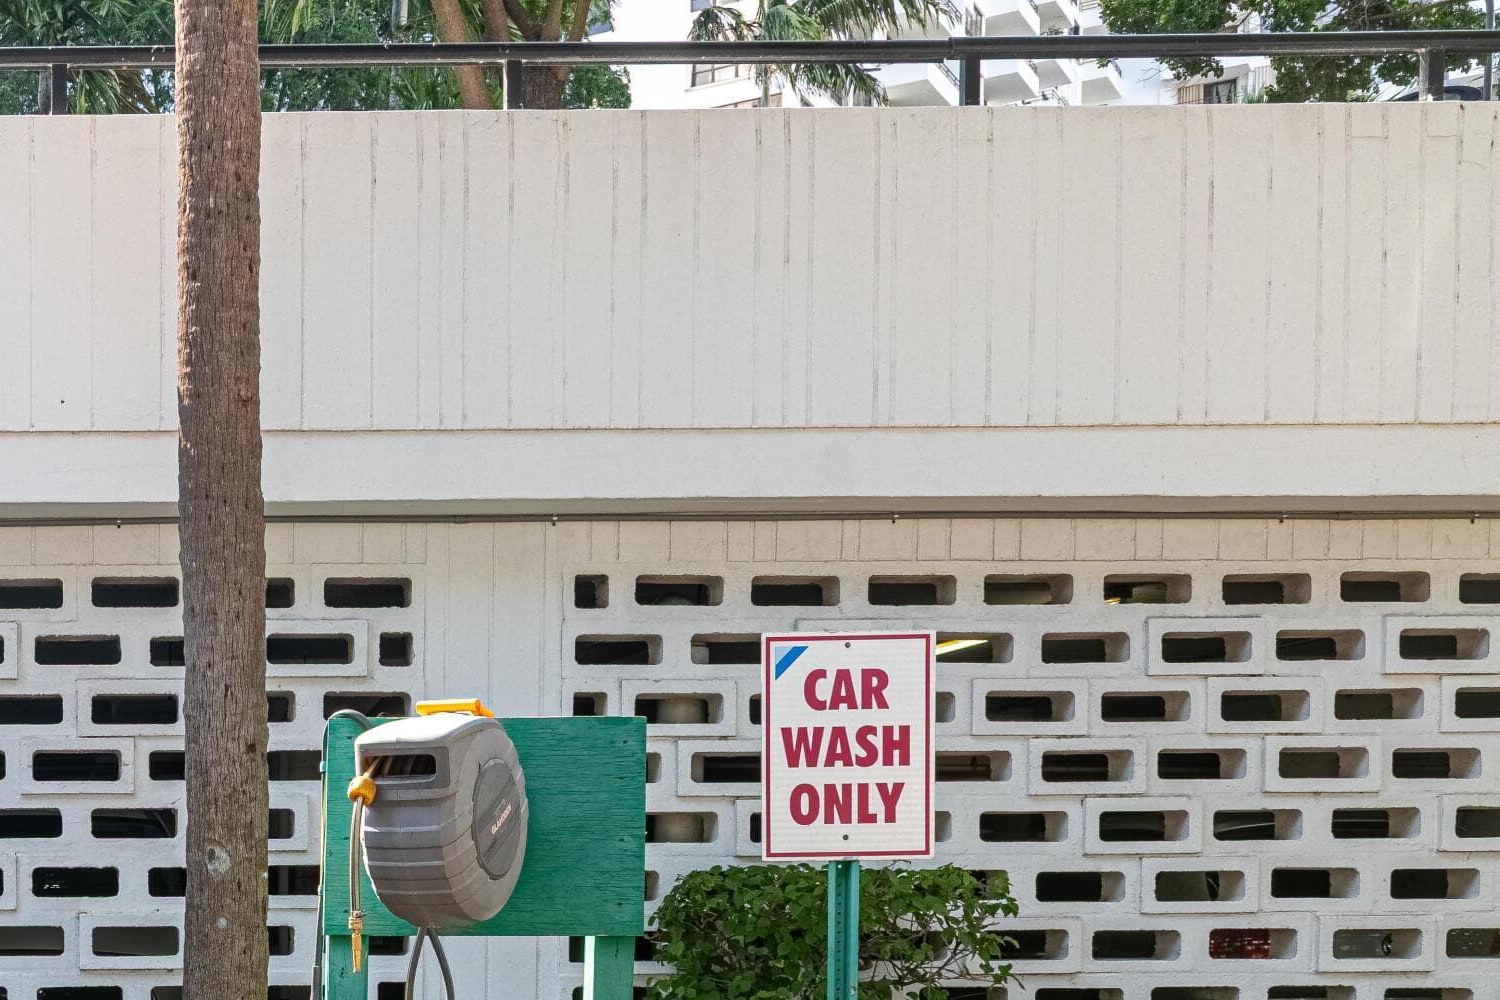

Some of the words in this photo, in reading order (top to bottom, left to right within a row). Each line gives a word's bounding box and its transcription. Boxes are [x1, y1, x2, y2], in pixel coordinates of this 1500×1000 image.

[803, 668, 890, 711] CAR
[780, 725, 911, 769] WASH
[789, 782, 905, 826] ONLY
